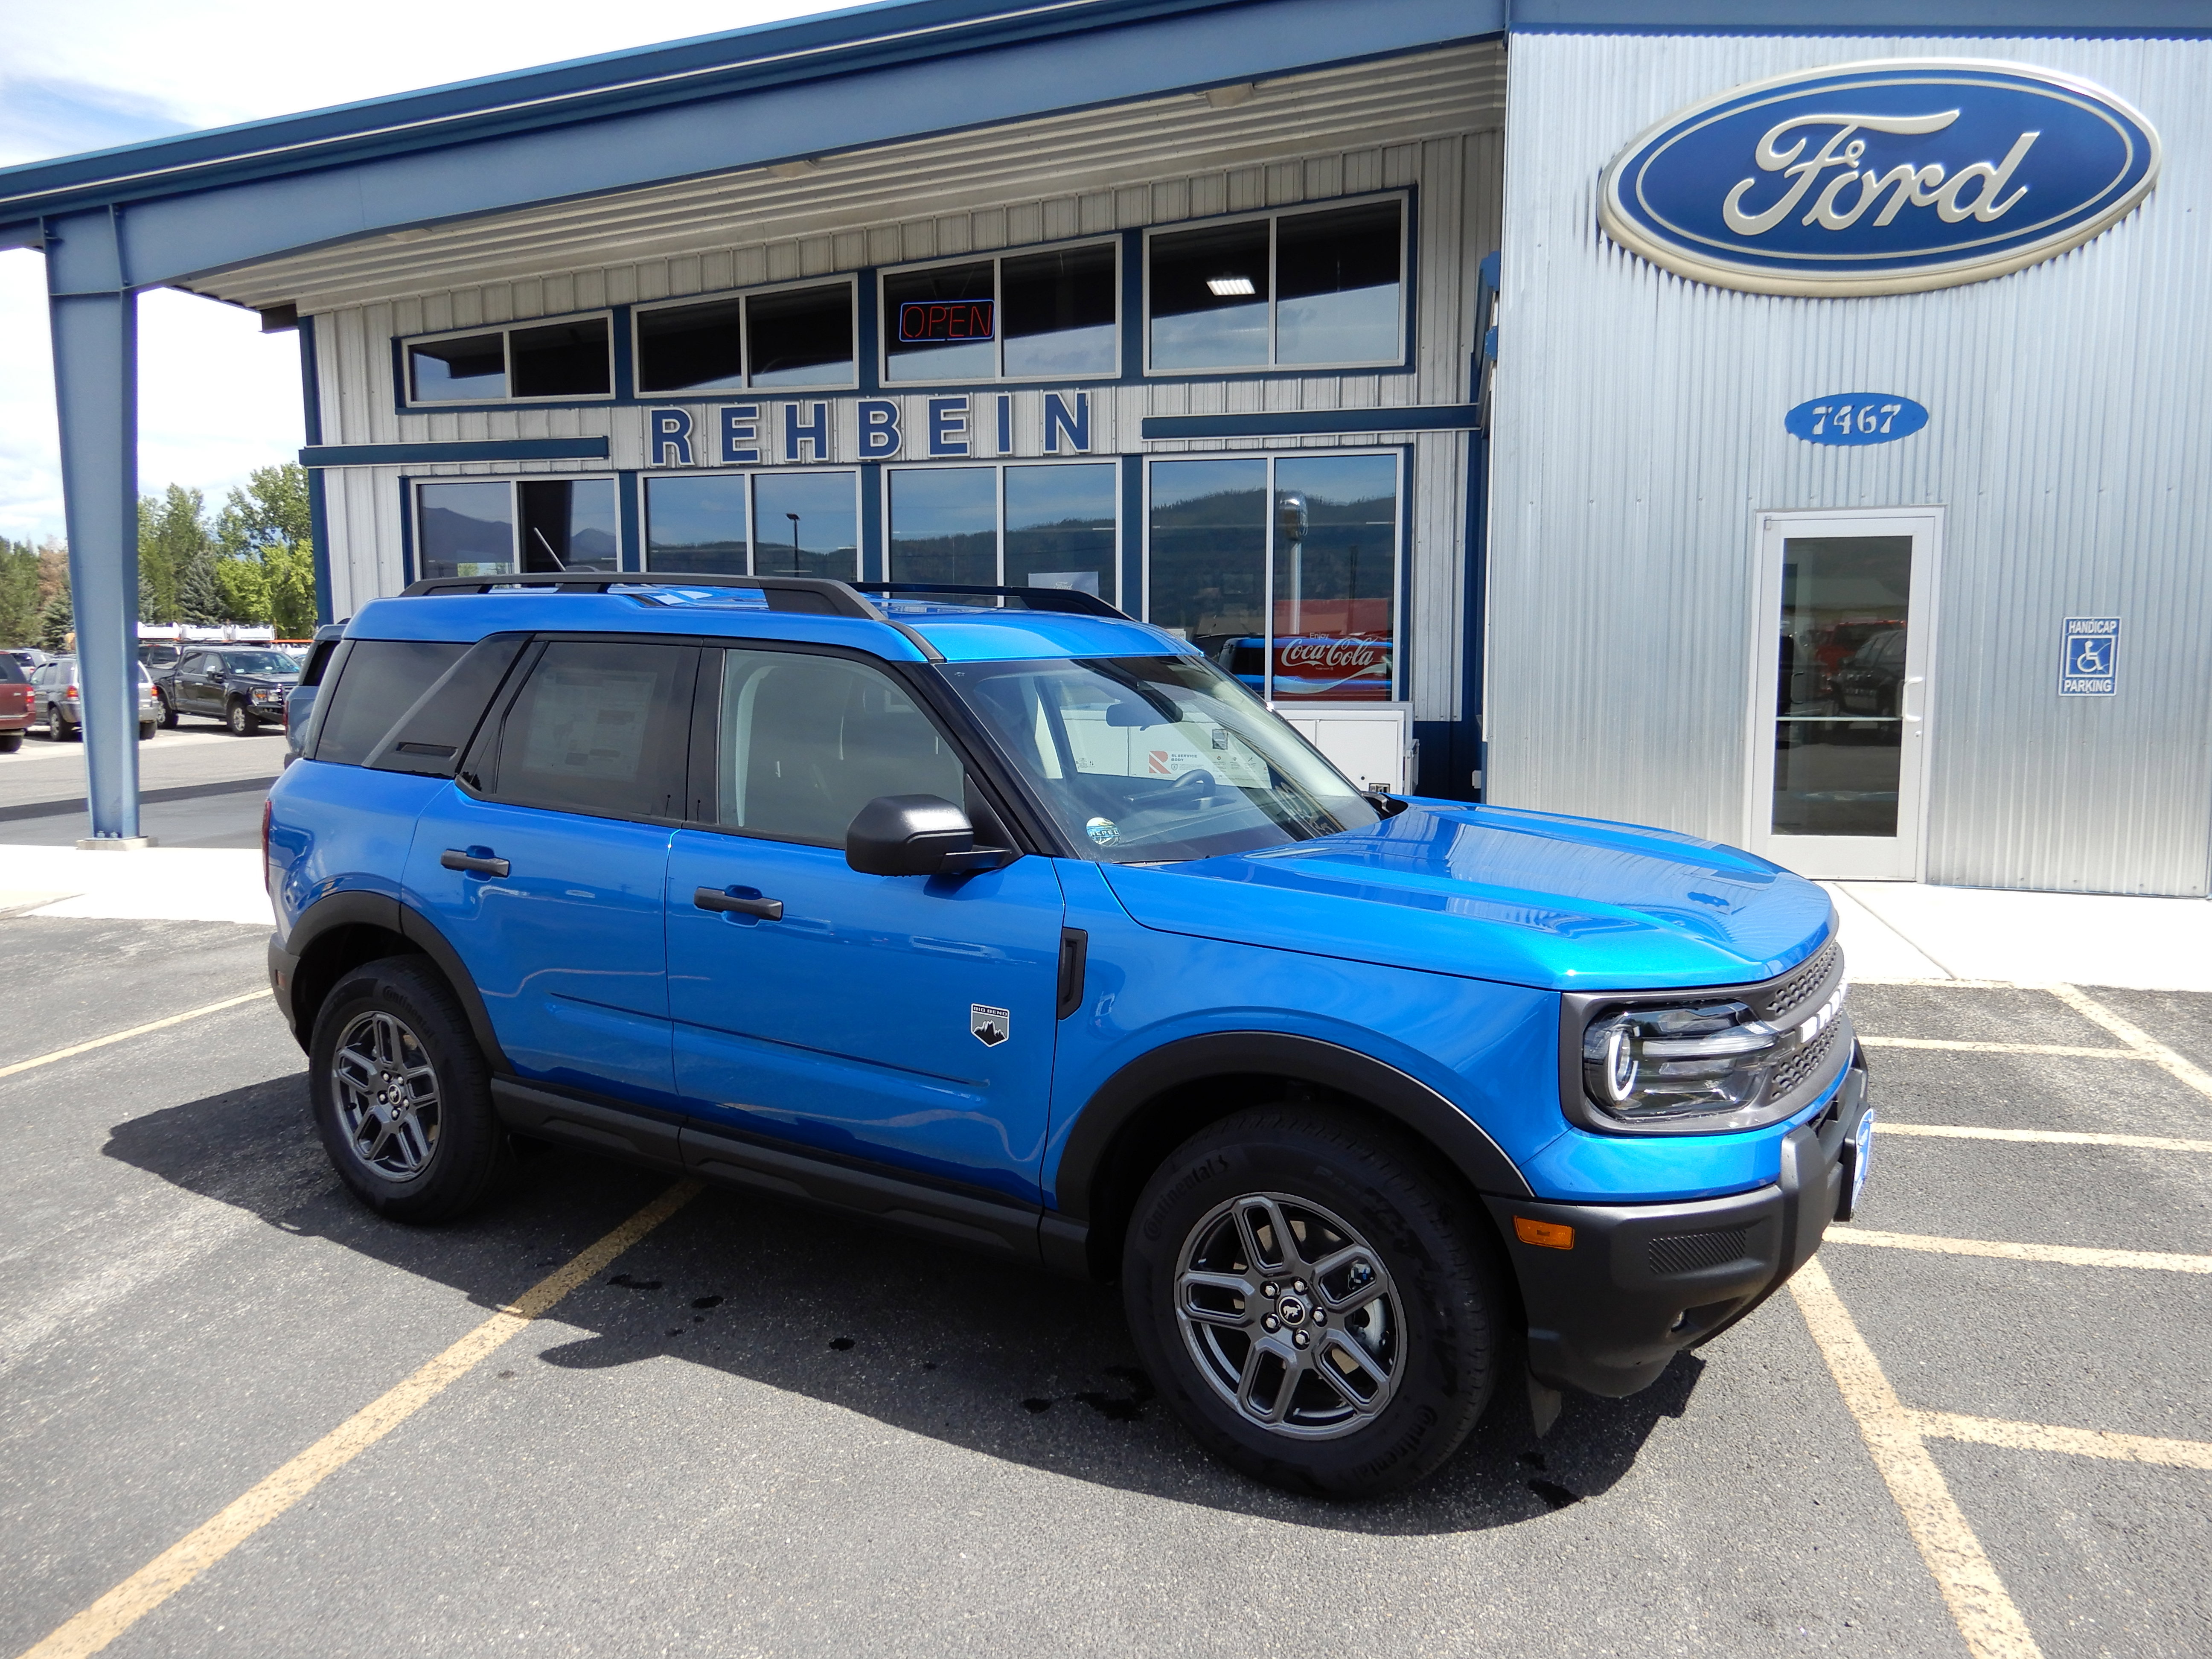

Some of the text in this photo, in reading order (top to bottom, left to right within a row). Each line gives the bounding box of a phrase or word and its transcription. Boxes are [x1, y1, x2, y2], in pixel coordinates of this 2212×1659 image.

[1723, 109, 2040, 236] Ford
[903, 304, 992, 338] OPEN
[649, 390, 1092, 467] REHBEIN
[1812, 404, 1902, 435] 7467
[2068, 620, 2117, 634] HANDICAP
[1281, 637, 1378, 667] Coca-Cola
[2064, 680, 2112, 692] PARKING
